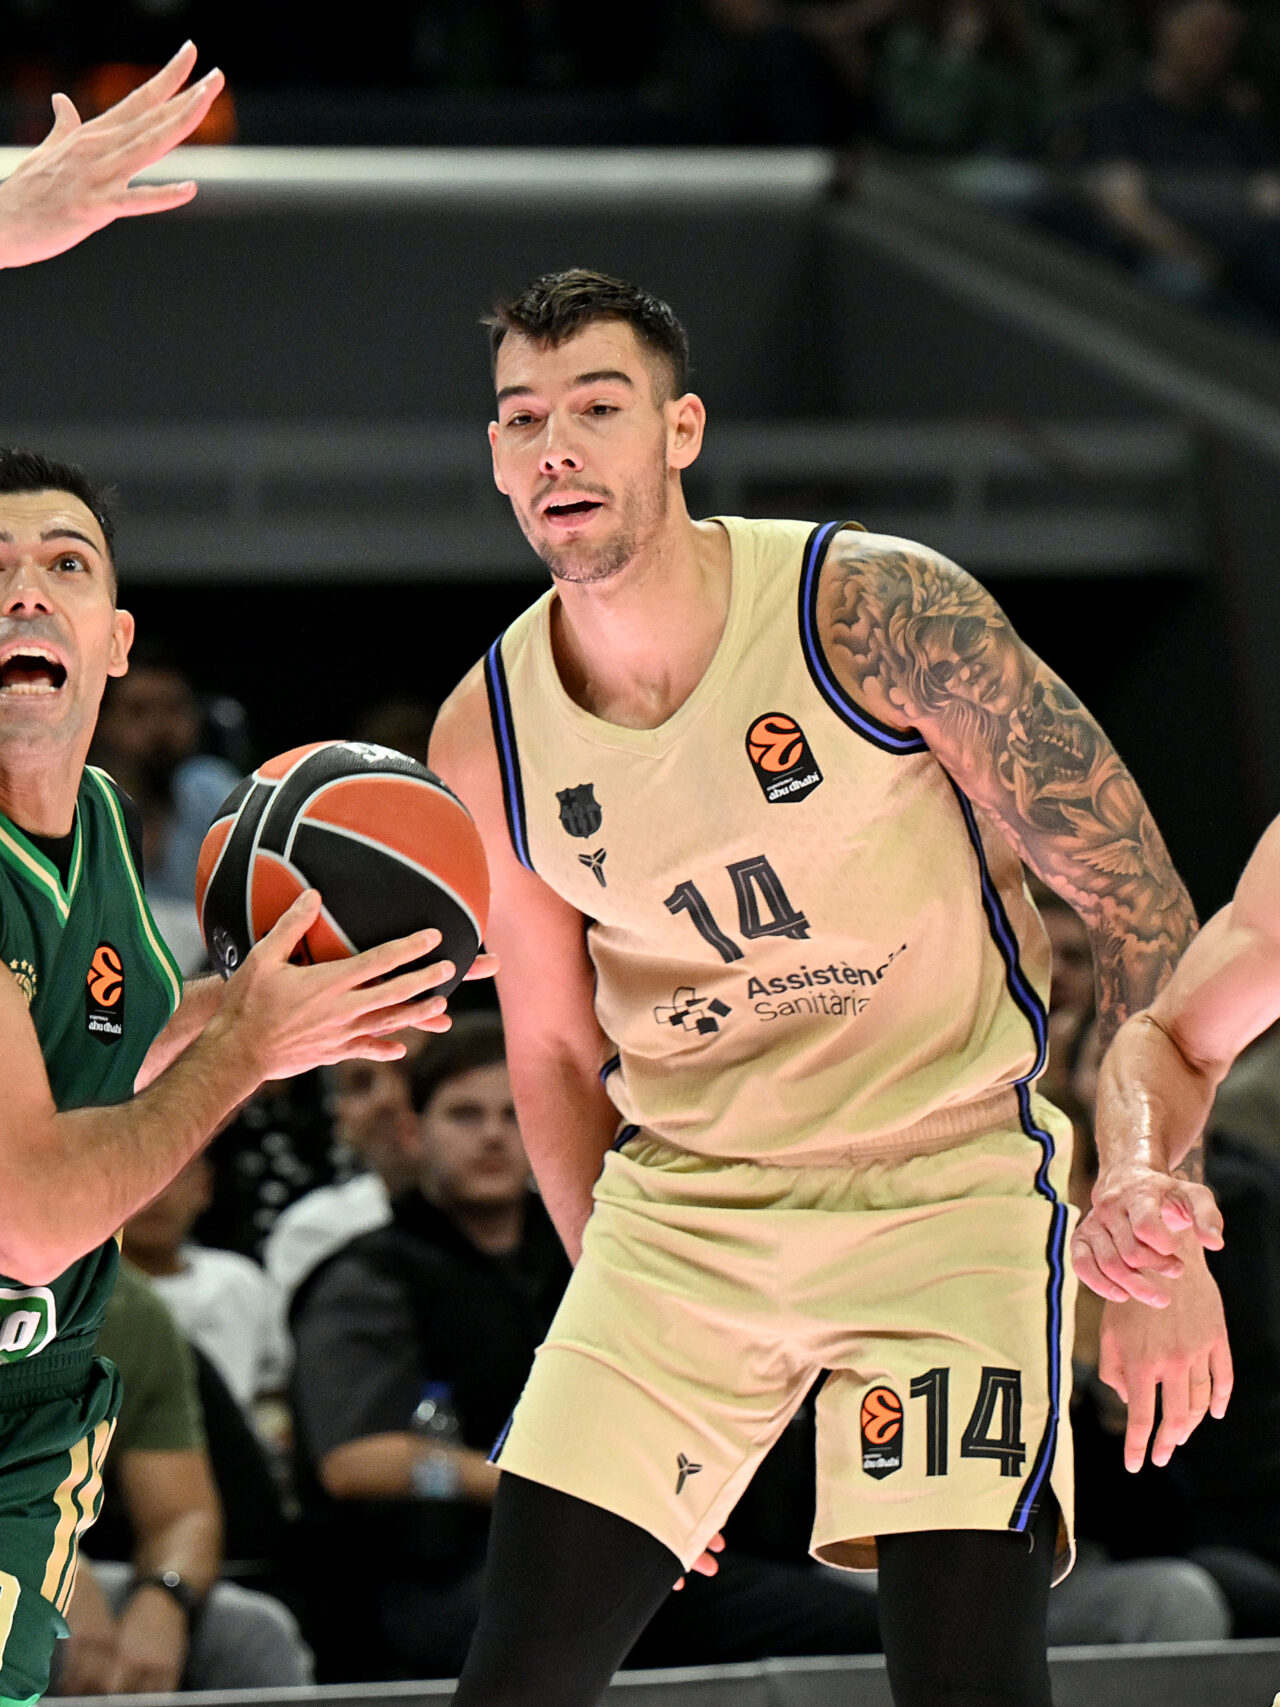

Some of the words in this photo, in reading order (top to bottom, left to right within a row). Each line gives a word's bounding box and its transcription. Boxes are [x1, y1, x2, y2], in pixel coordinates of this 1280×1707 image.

[663, 854, 812, 964] 14
[747, 943, 908, 1000] Assistènc
[909, 1366, 1026, 1478] 14
